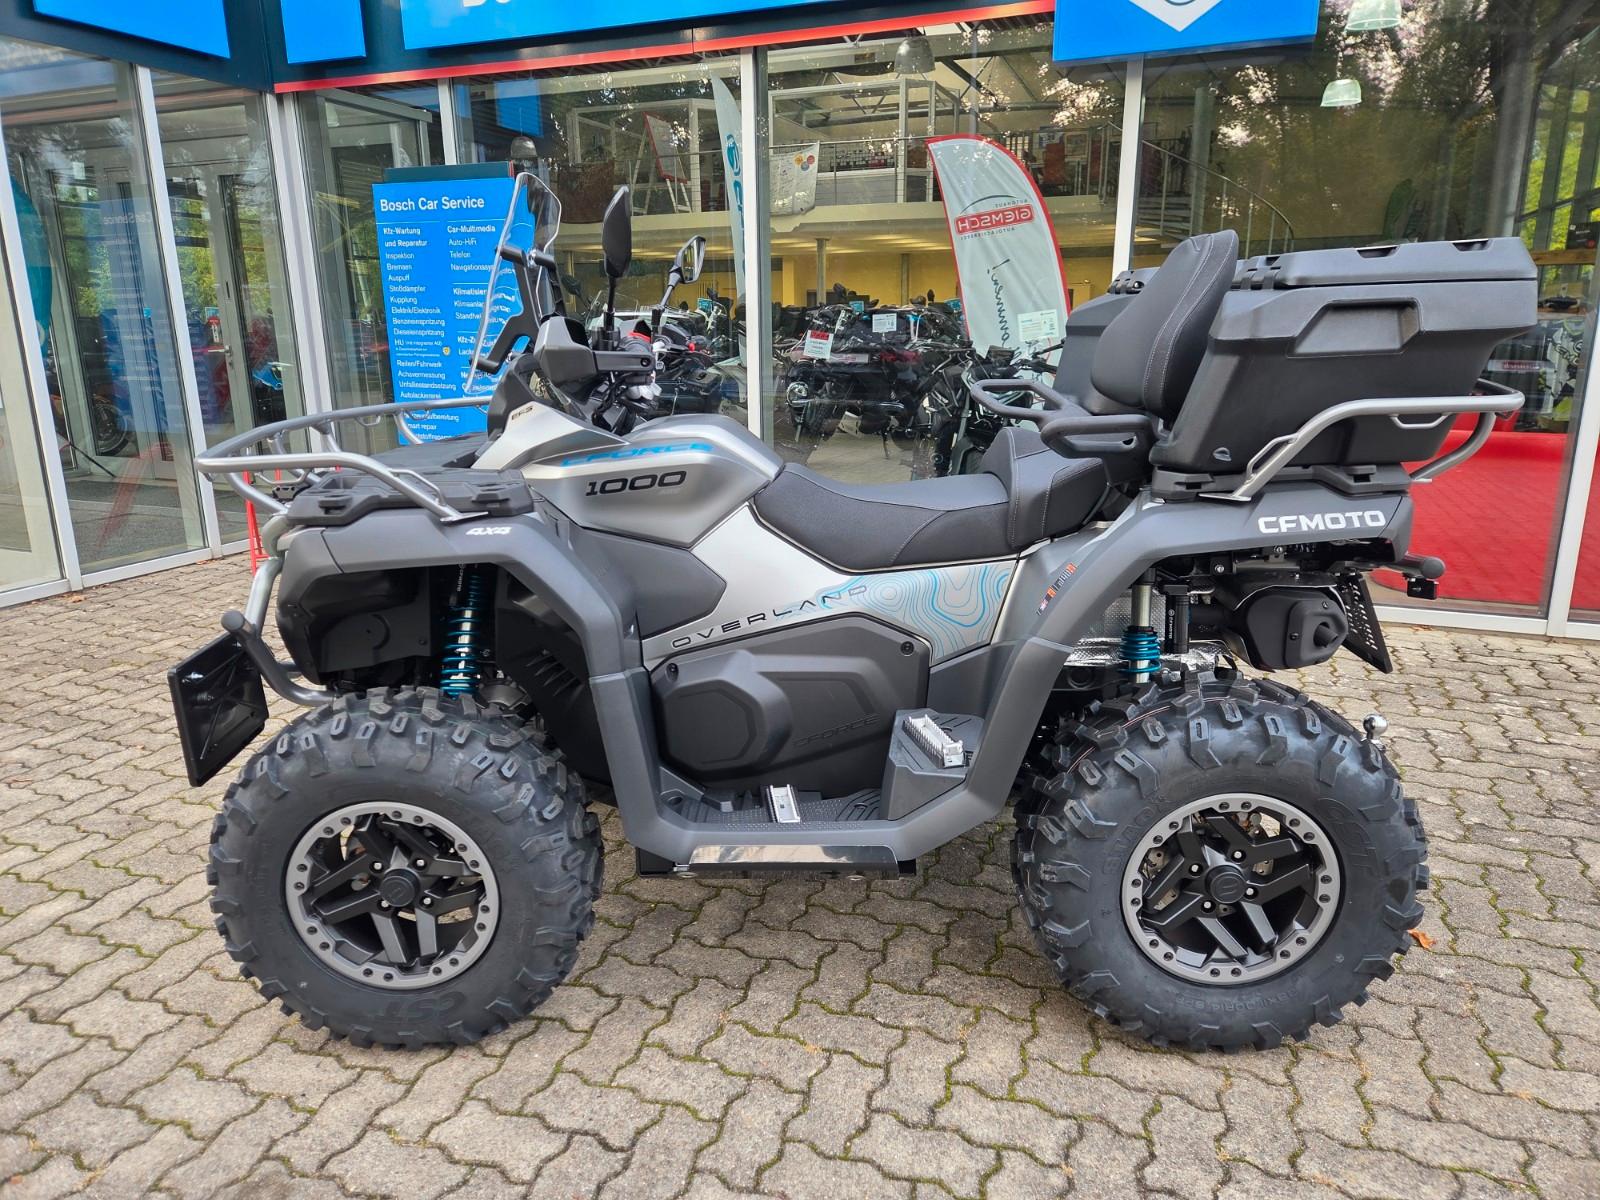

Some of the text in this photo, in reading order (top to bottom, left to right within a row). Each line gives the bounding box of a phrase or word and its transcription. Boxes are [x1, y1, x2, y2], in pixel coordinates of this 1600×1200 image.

[380, 196, 485, 211] Bosch Car Service
[383, 227, 421, 236] Kfz-Wartung
[447, 224, 496, 233] Car-Multimedia
[397, 239, 428, 248] Reparatur
[448, 237, 477, 246] Auto-HiFi
[385, 251, 415, 260] Inspektion
[449, 250, 471, 258] Telefon
[386, 263, 413, 271] Bremsen
[388, 274, 410, 283] Auspuff
[389, 296, 418, 305] Kupplung
[391, 306, 441, 314] Elektrik/Elektronik
[393, 328, 445, 338] Dieseleinspritzung
[396, 359, 442, 368] Reifen/Fahrwerk
[397, 370, 446, 380] Achsvermessung
[585, 470, 687, 497] 1000
[1257, 510, 1387, 534] CFMOTO
[671, 584, 868, 649] OVERLAND
